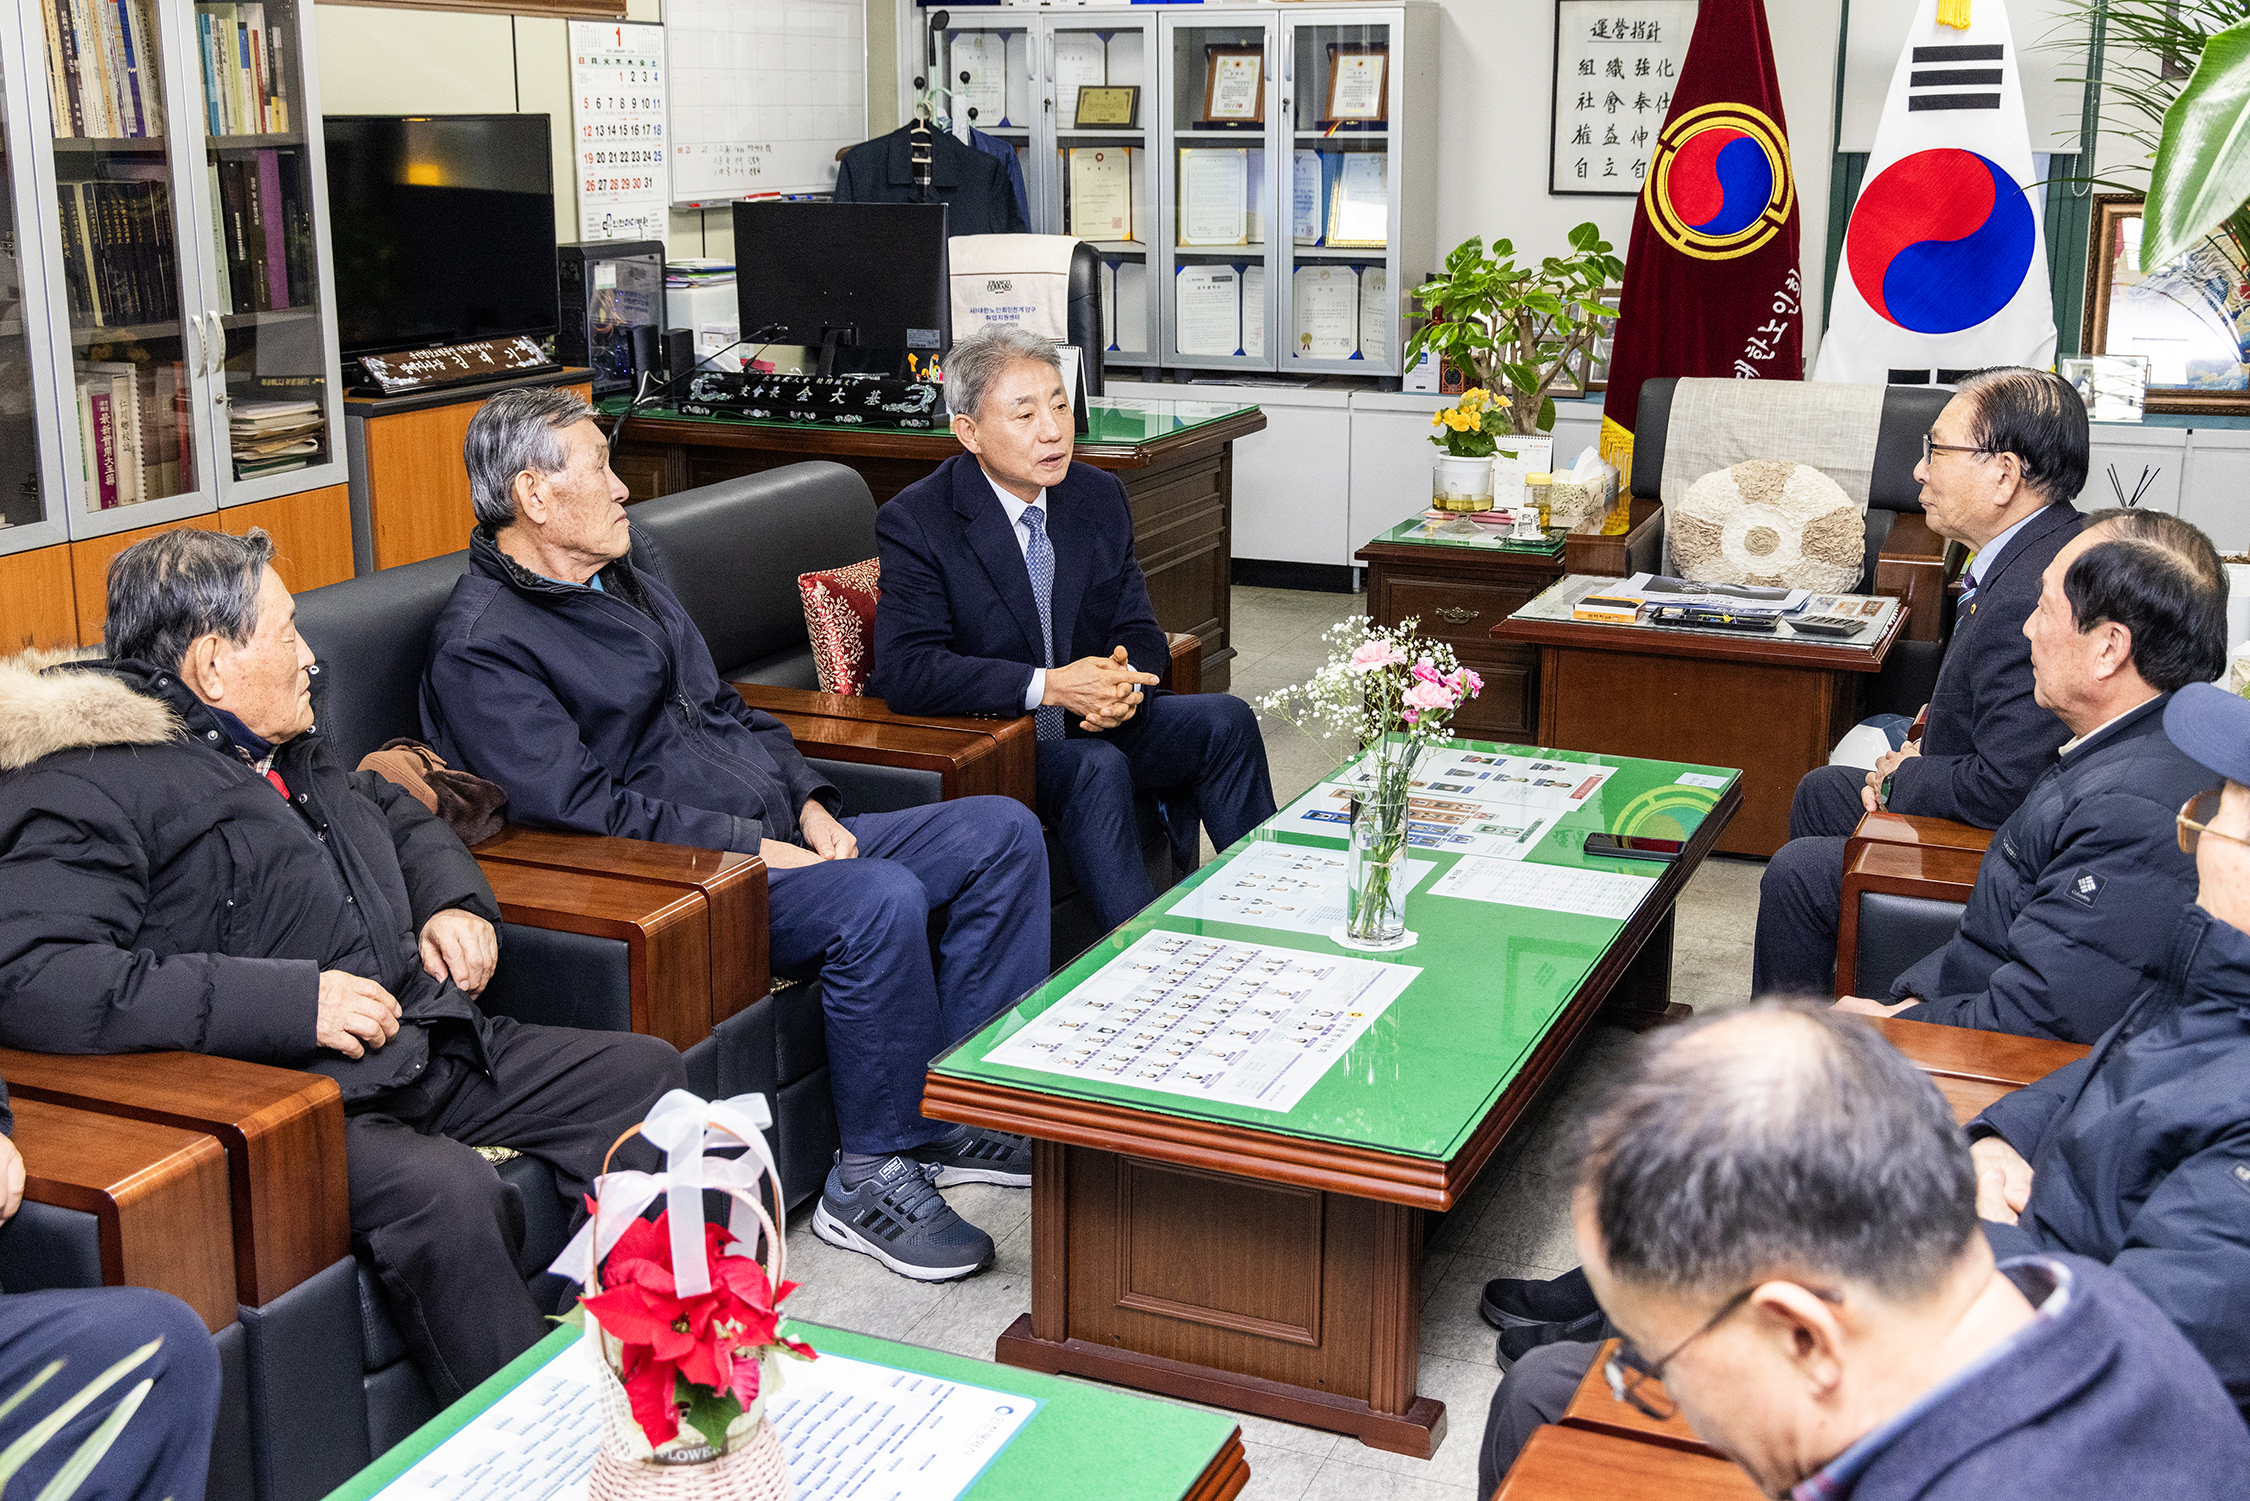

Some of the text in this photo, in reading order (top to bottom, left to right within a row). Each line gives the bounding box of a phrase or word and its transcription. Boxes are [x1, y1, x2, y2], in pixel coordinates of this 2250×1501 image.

[615, 26, 622, 47] 1
[642, 98, 650, 109] 10
[653, 99, 661, 109] 11
[583, 125, 662, 137] 12 13 14 15 16 17 18
[1571, 124, 1661, 149] 權益伸
[584, 151, 662, 164] 19 20 21 22 23 24 25
[586, 177, 652, 191] 26 27 28 29 30 31
[659, 1445, 722, 1462] LOWE
